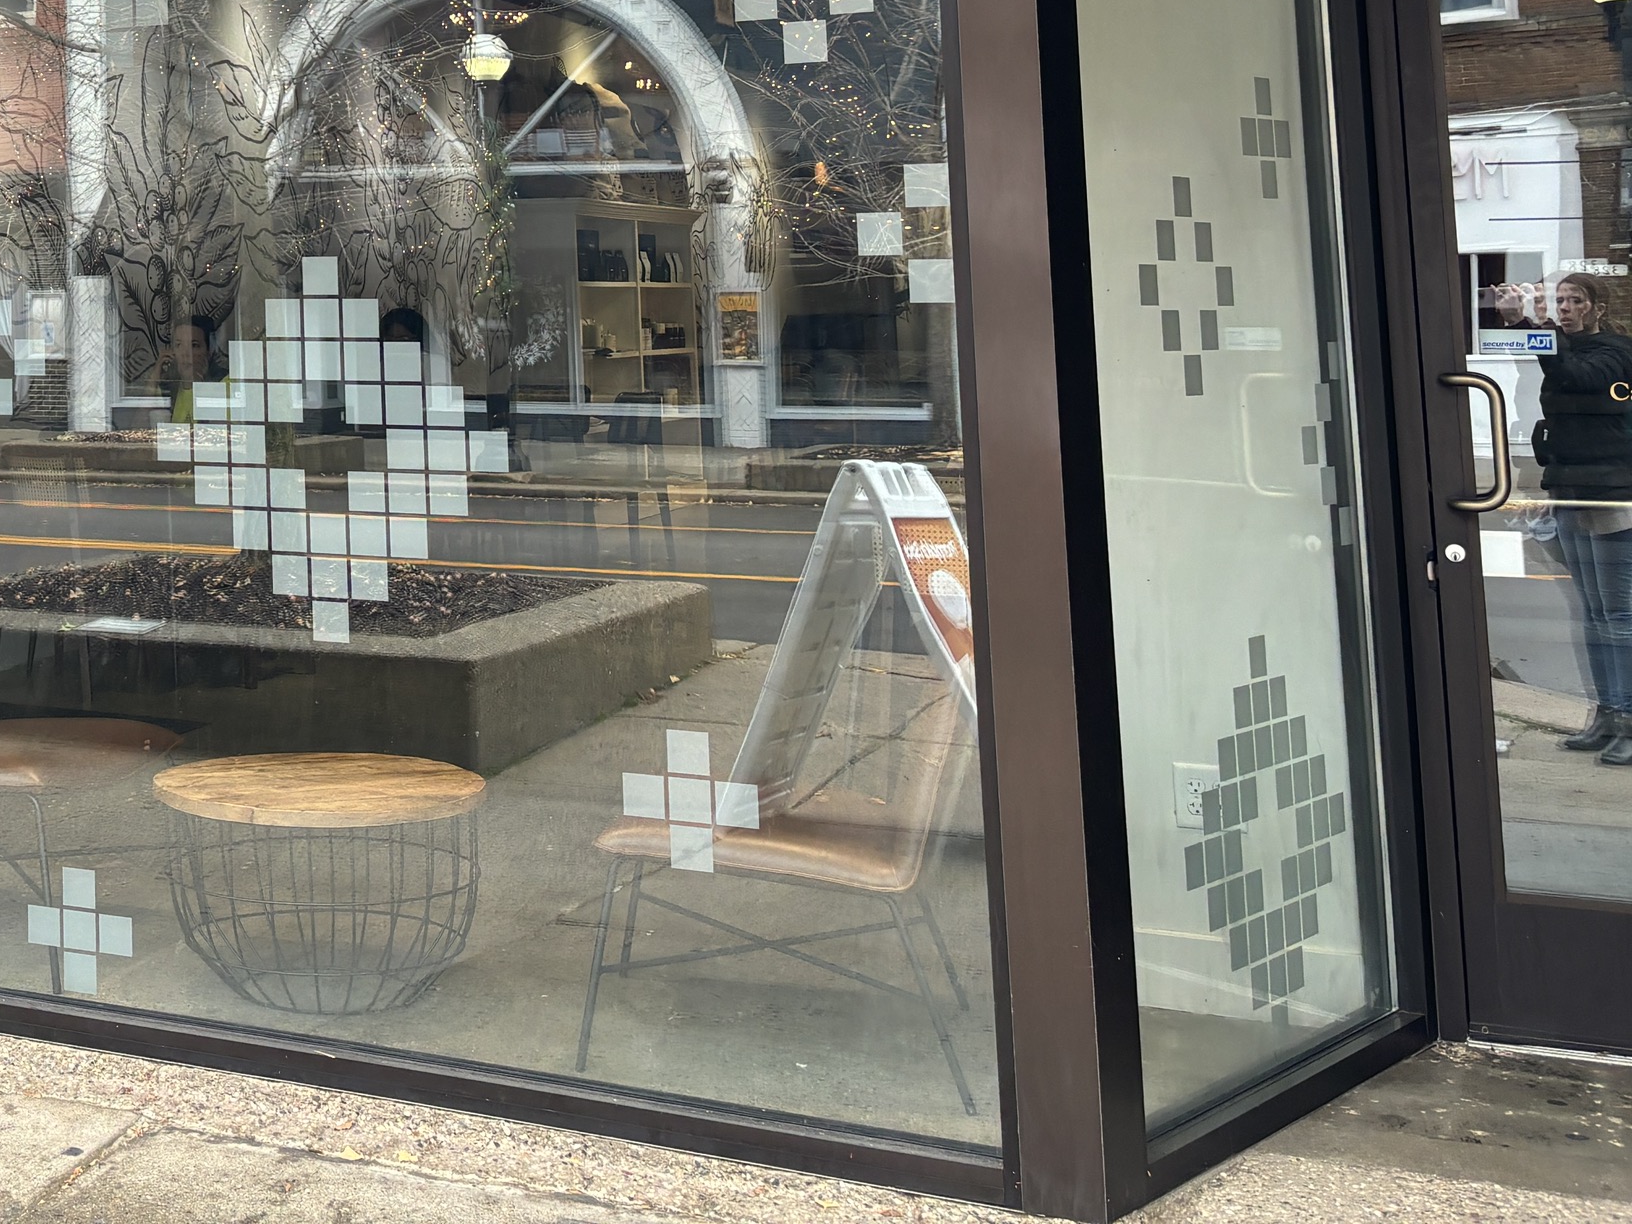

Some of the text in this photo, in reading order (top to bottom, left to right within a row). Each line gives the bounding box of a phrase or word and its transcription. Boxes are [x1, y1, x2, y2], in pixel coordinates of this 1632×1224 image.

[1482, 336, 1552, 349] secured by ADT
